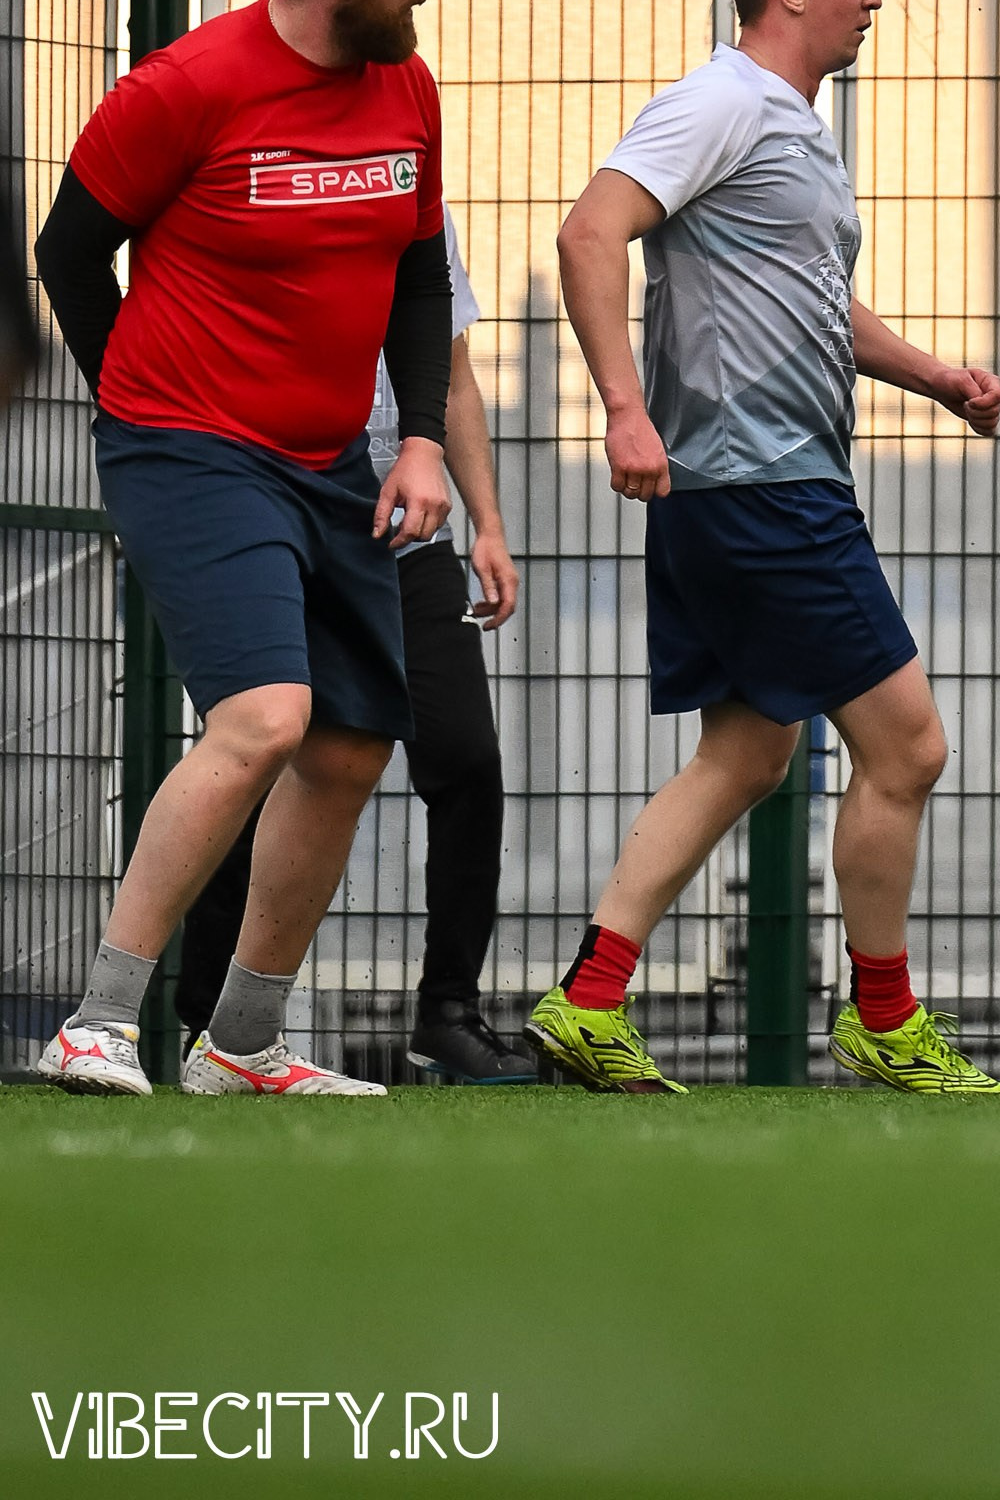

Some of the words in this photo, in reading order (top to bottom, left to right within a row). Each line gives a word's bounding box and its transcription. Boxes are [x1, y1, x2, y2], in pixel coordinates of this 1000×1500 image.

[250, 152, 265, 162] 2K
[265, 150, 291, 160] SPORT
[291, 166, 389, 194] SPAR
